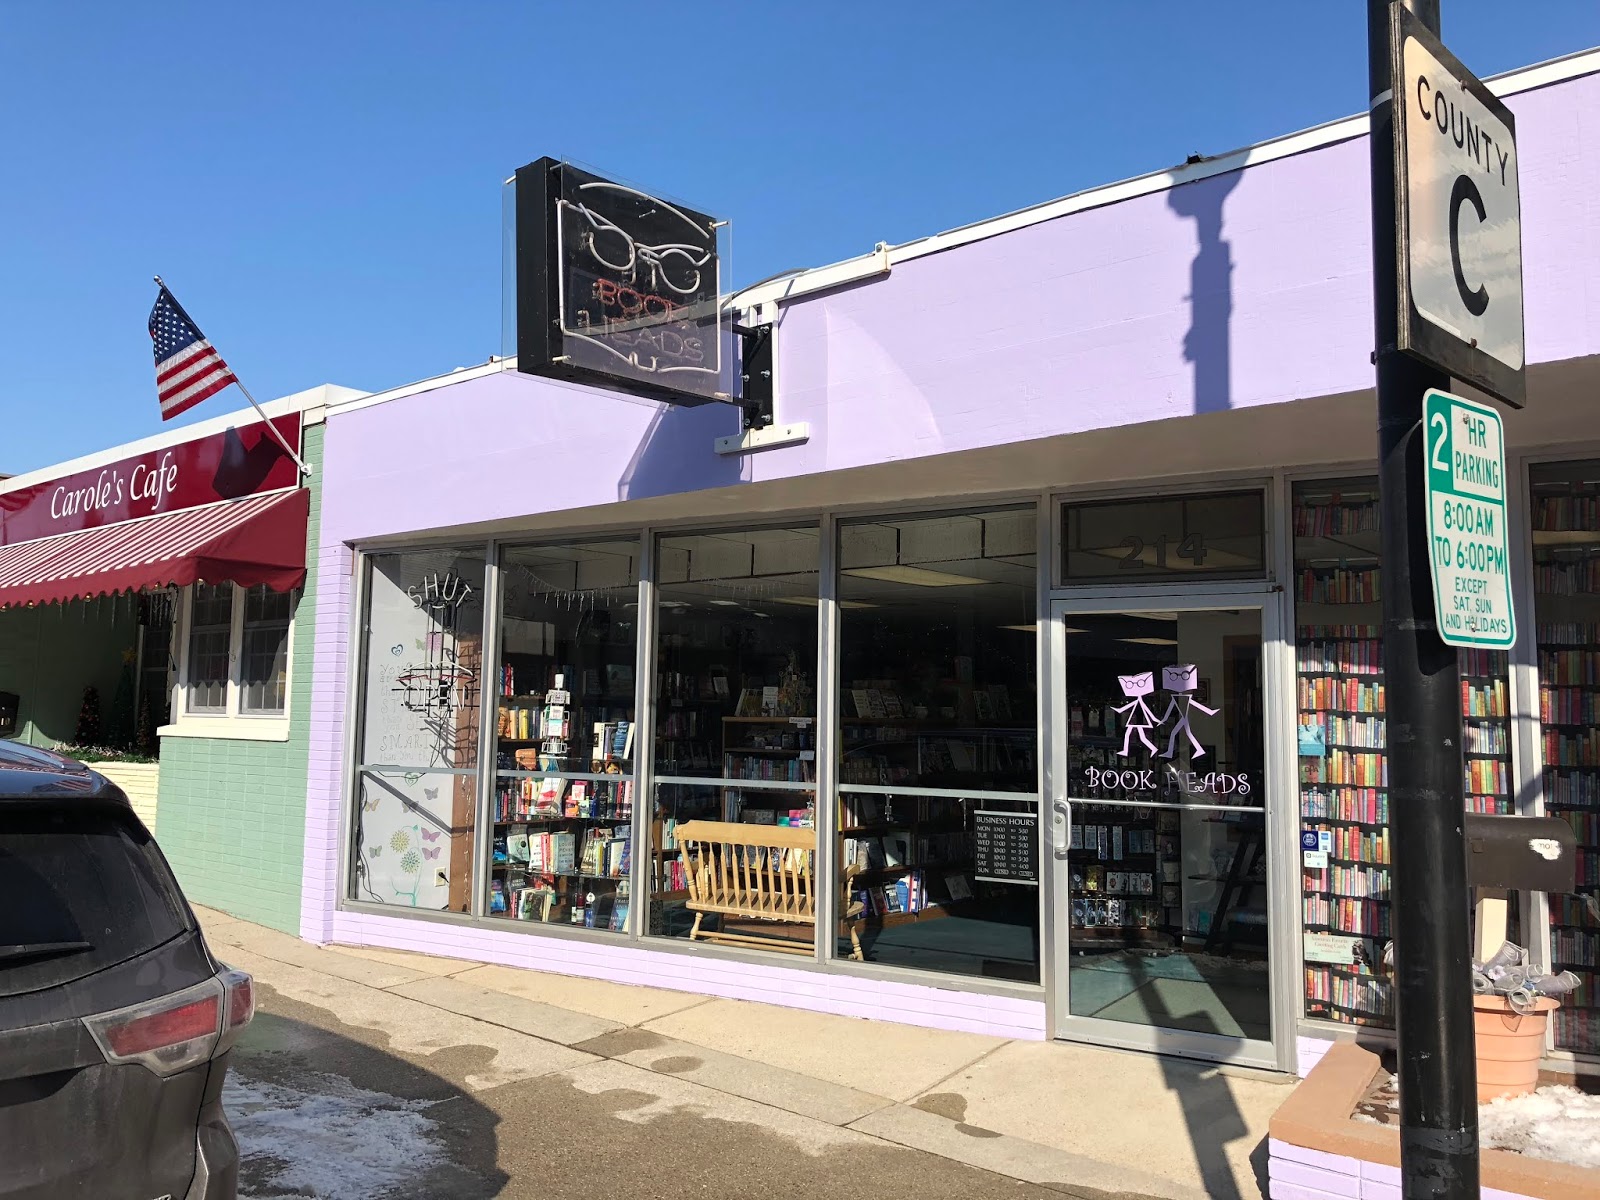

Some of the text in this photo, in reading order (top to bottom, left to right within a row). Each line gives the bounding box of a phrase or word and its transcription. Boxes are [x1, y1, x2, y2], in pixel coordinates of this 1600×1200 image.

[1418, 75, 1508, 186] COUNTY
[1450, 174, 1489, 317] C
[1430, 411, 1487, 472] 2 HR
[51, 451, 179, 519] Carole's Cafe
[1455, 450, 1499, 489] PARKING
[1118, 533, 1208, 569] 214
[1435, 535, 1451, 567] TO
[408, 573, 472, 609] SHUT
[1455, 576, 1488, 595] EXCEPT
[1445, 612, 1461, 629] AND
[1475, 597, 1492, 614] SUN
[403, 684, 466, 712] OPEN
[1085, 766, 1251, 795] BOOK HEADS
[976, 816, 1035, 826] BUSINESS HOURS
